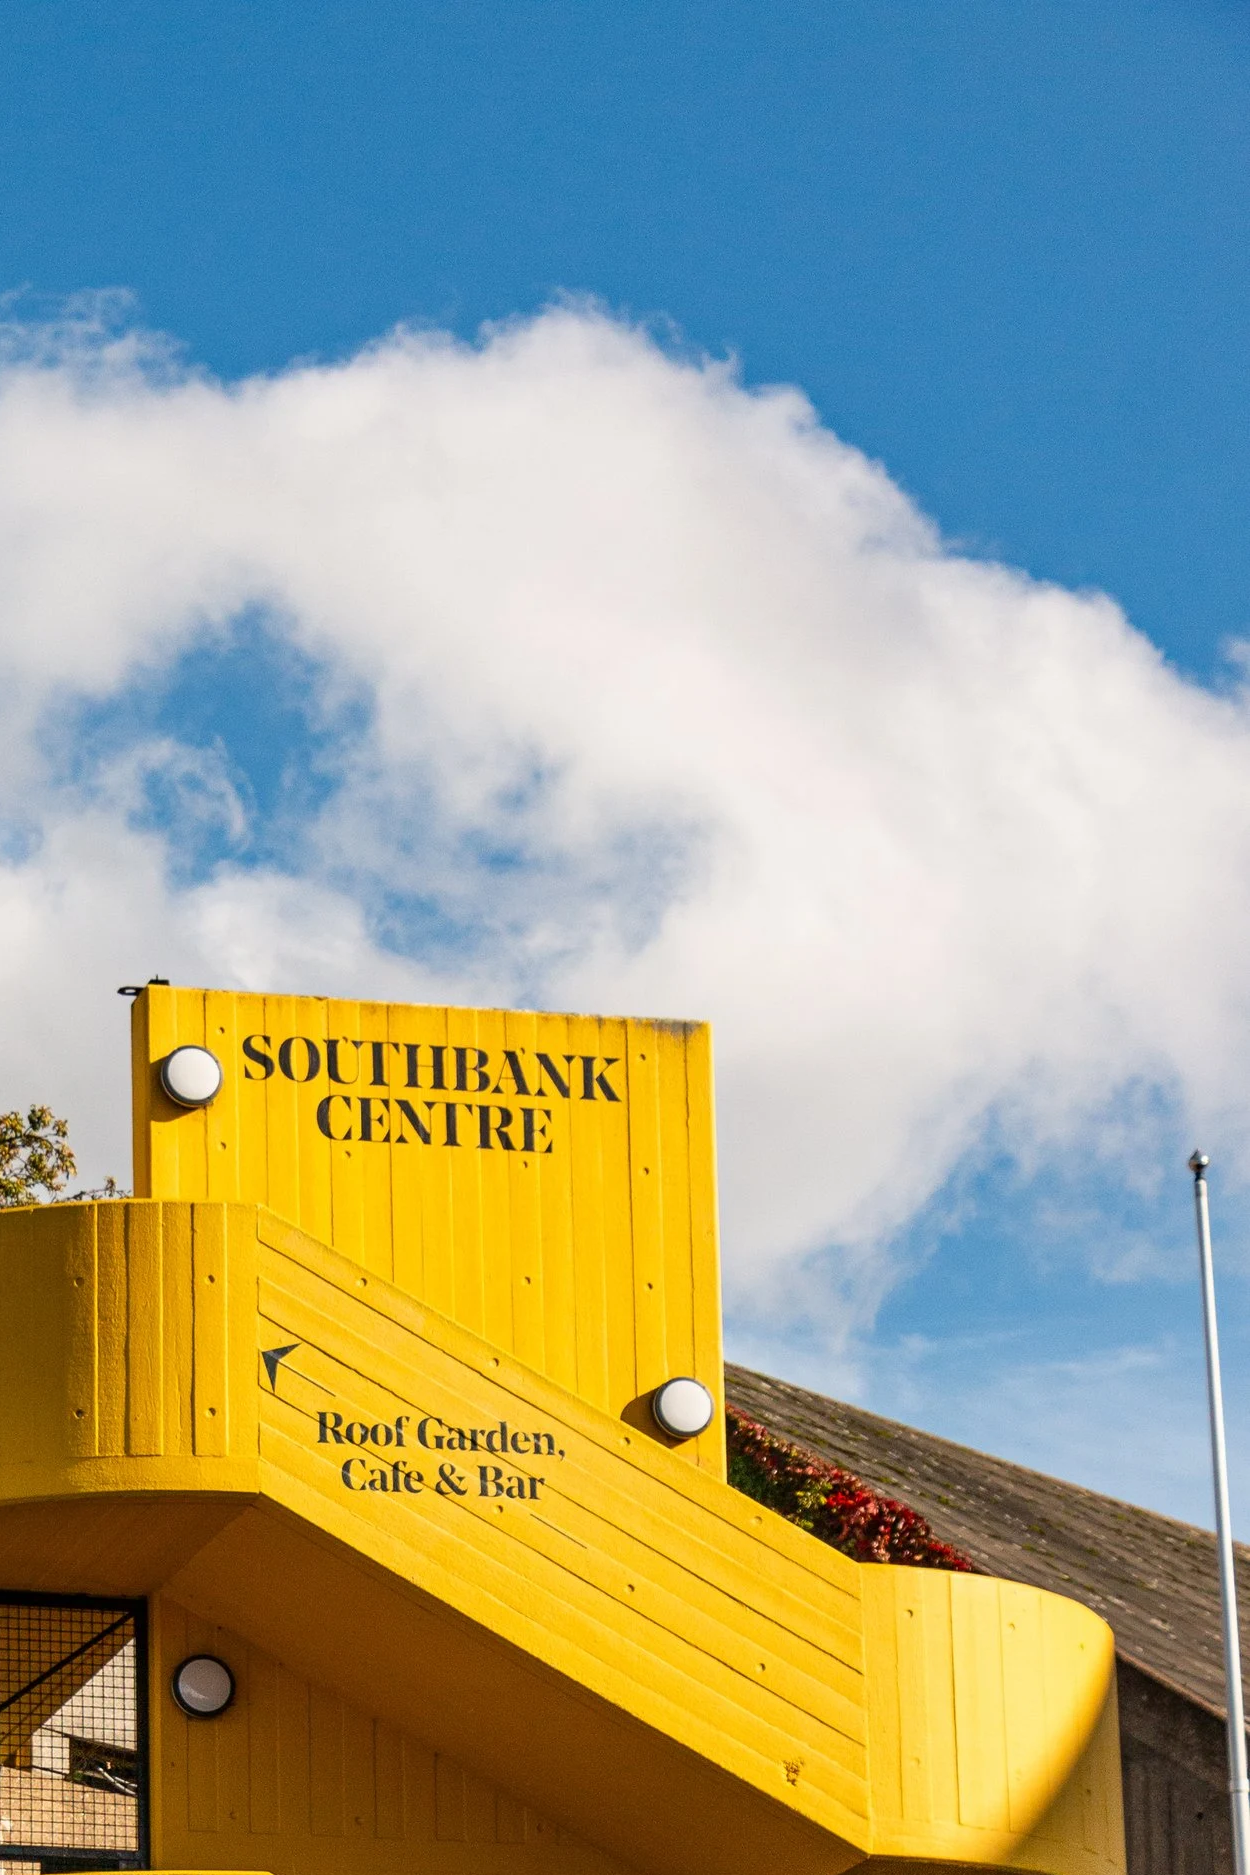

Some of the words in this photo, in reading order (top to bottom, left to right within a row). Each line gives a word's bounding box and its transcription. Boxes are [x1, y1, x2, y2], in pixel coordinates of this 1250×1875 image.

[242, 1034, 623, 1102] SOUTHBANK
[316, 1095, 553, 1154] CENTRE
[317, 1411, 410, 1448] Roof
[417, 1416, 565, 1461] Garden,
[341, 1457, 424, 1494] Cafe
[435, 1463, 468, 1496] &
[477, 1465, 545, 1500] Bar
